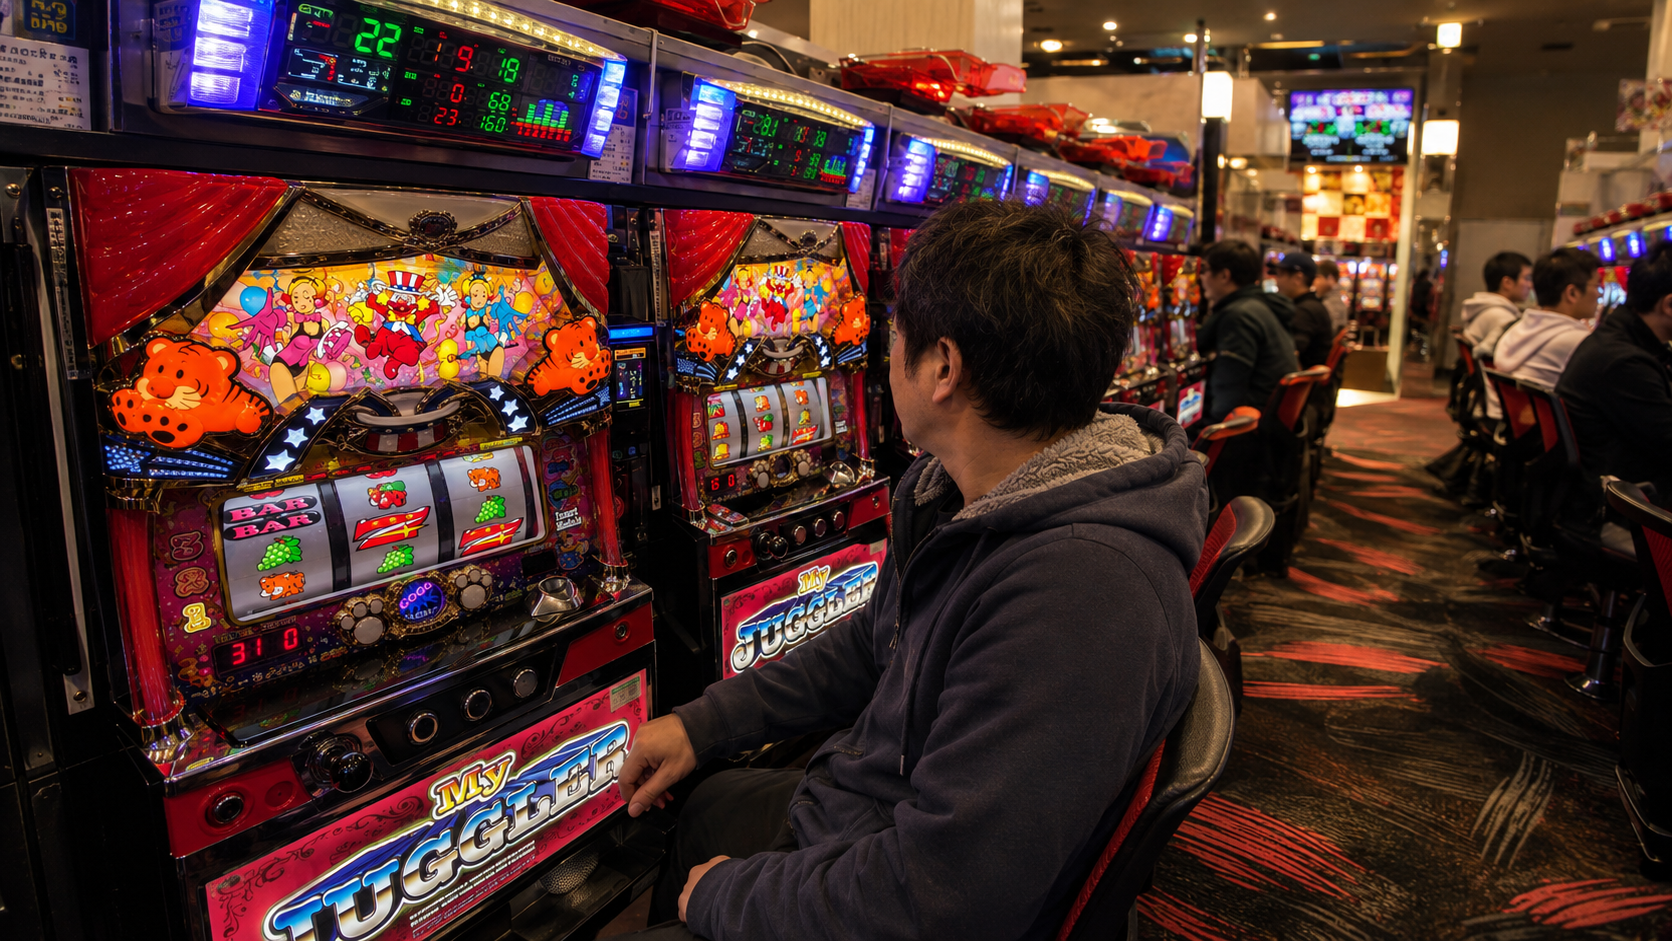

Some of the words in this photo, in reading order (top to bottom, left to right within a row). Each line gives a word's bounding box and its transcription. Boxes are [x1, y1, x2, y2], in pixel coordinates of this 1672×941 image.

[355, 17, 401, 58] 22
[450, 83, 465, 103] 0
[488, 91, 511, 111] 68
[434, 106, 459, 126] 23
[229, 498, 309, 522] BAR
[233, 514, 313, 539] BAR
[799, 567, 829, 595] My
[283, 627, 298, 650] 0
[436, 757, 511, 814] My
